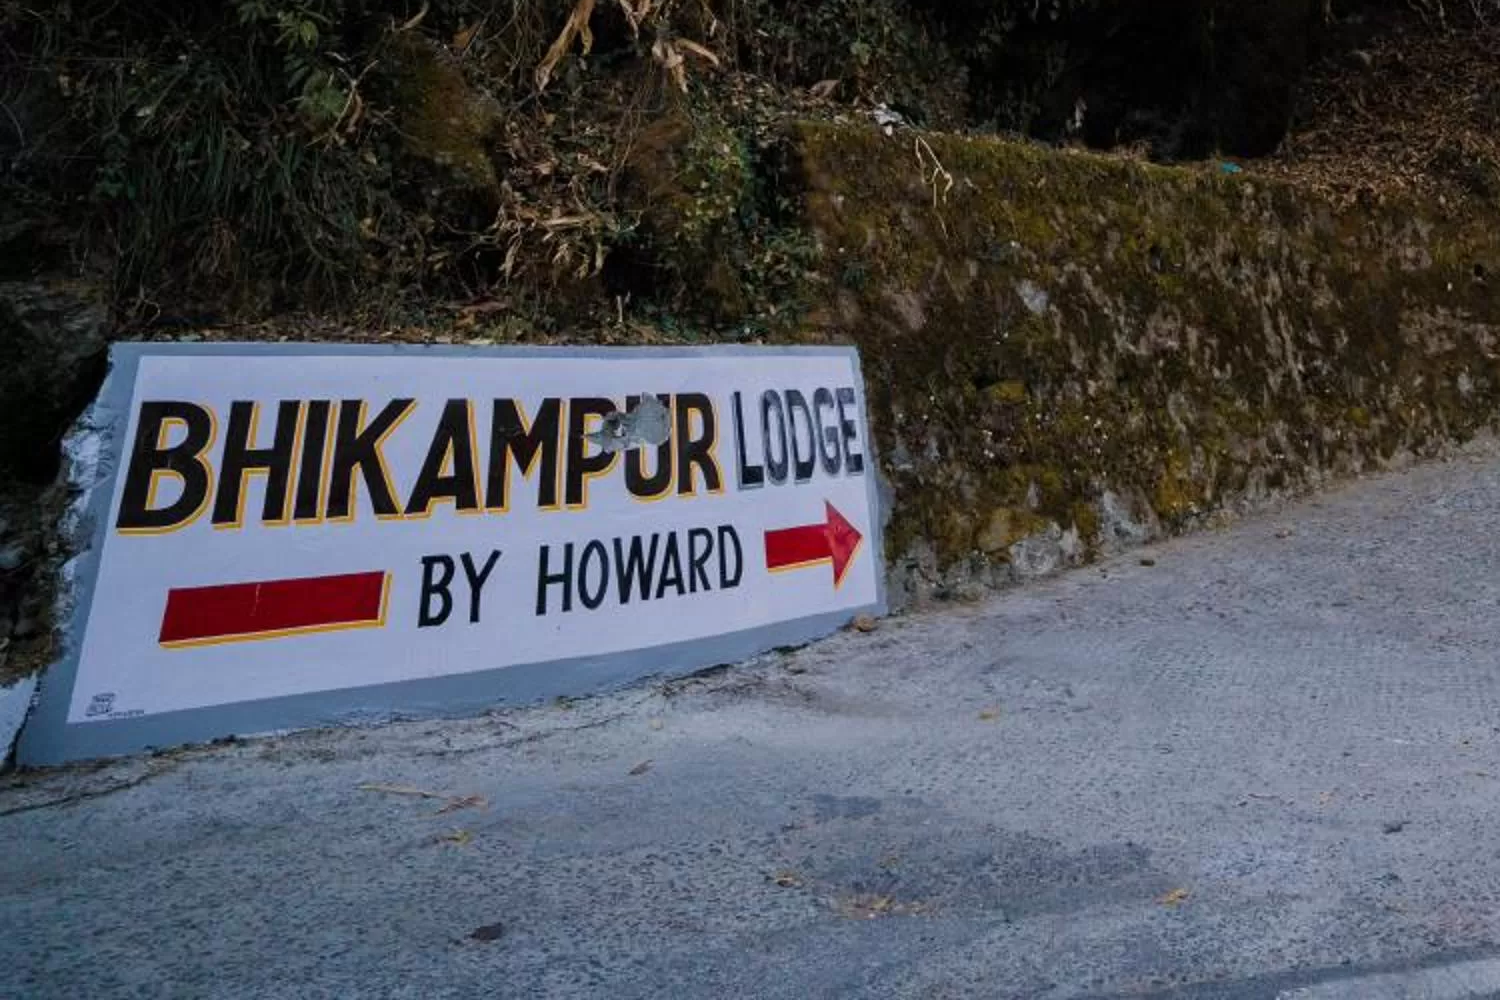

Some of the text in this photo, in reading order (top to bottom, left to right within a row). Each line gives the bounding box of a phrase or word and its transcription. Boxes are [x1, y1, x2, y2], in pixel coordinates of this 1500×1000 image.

[115, 387, 864, 535] BHIKAMPUR LODGE
[417, 524, 744, 628] BY HOWARD
